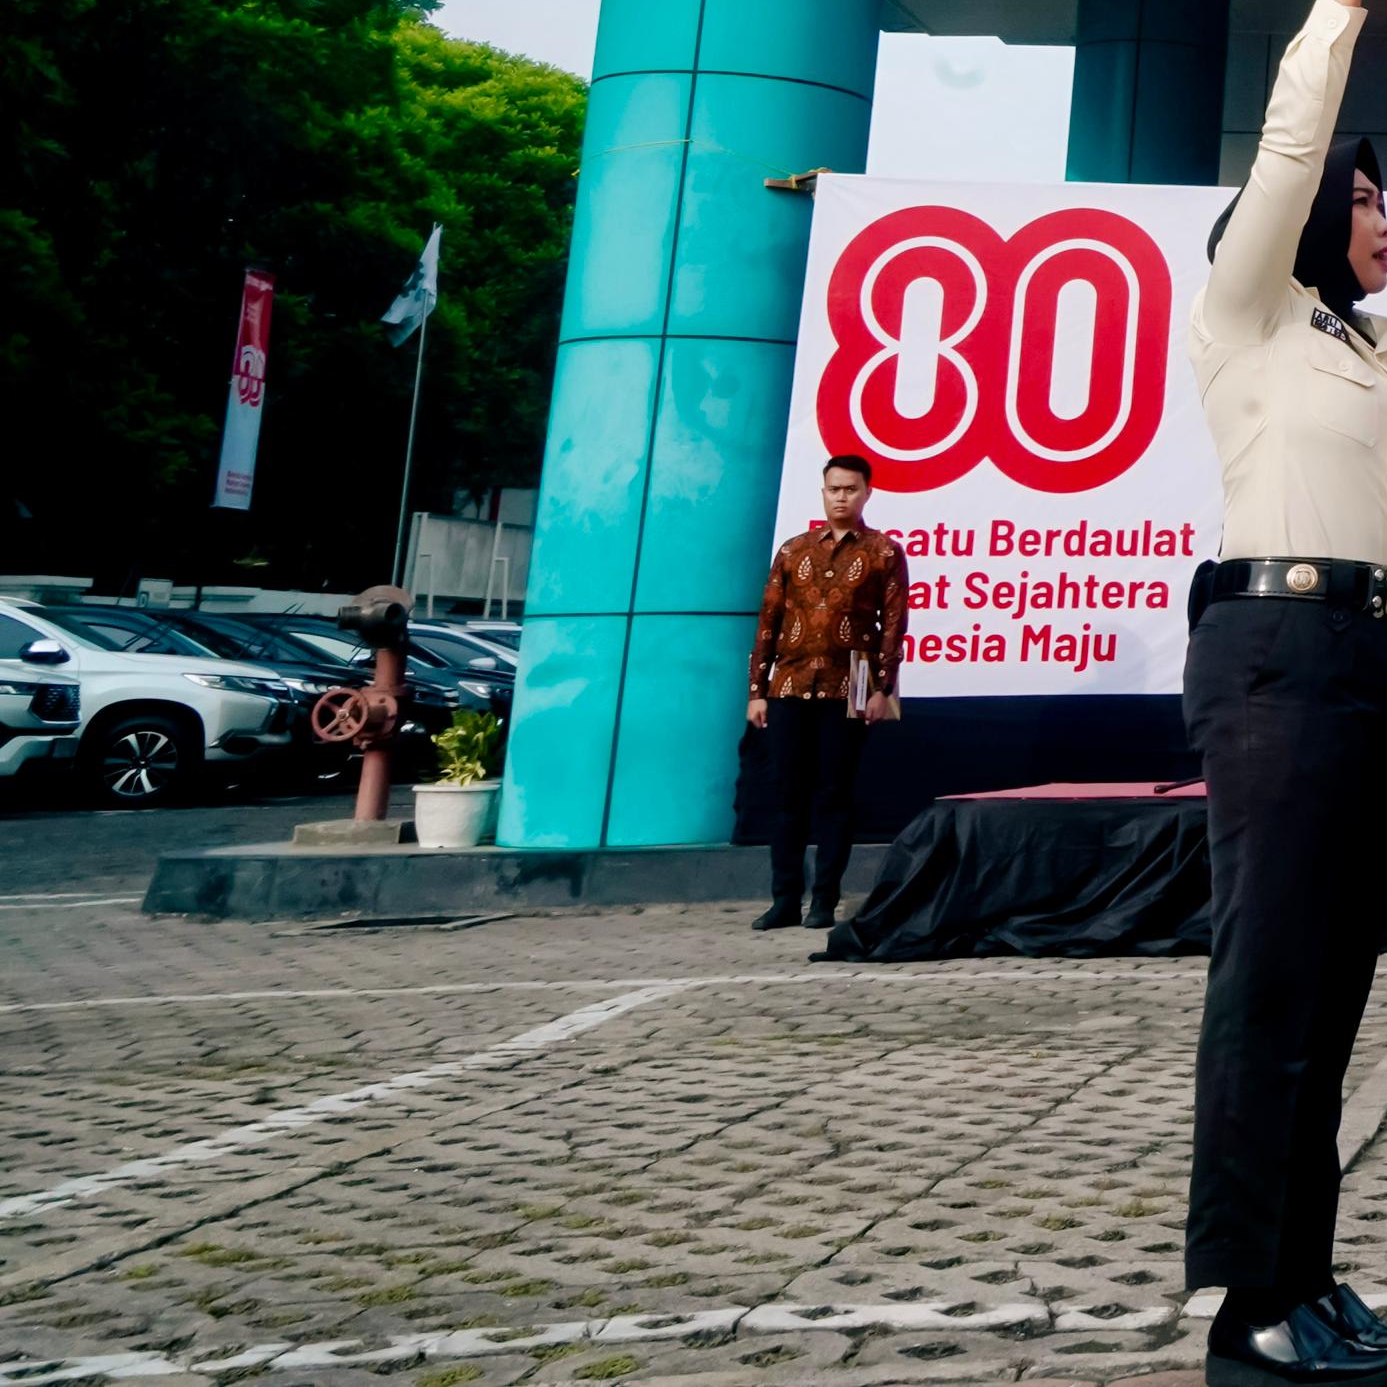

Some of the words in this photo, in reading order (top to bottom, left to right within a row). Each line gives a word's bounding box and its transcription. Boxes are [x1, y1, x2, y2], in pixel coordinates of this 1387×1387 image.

[815, 205, 1172, 493] 80
[989, 520, 1195, 557] Berdaulat
[964, 570, 1169, 620] Sejahtera
[1020, 623, 1117, 672] Maju
